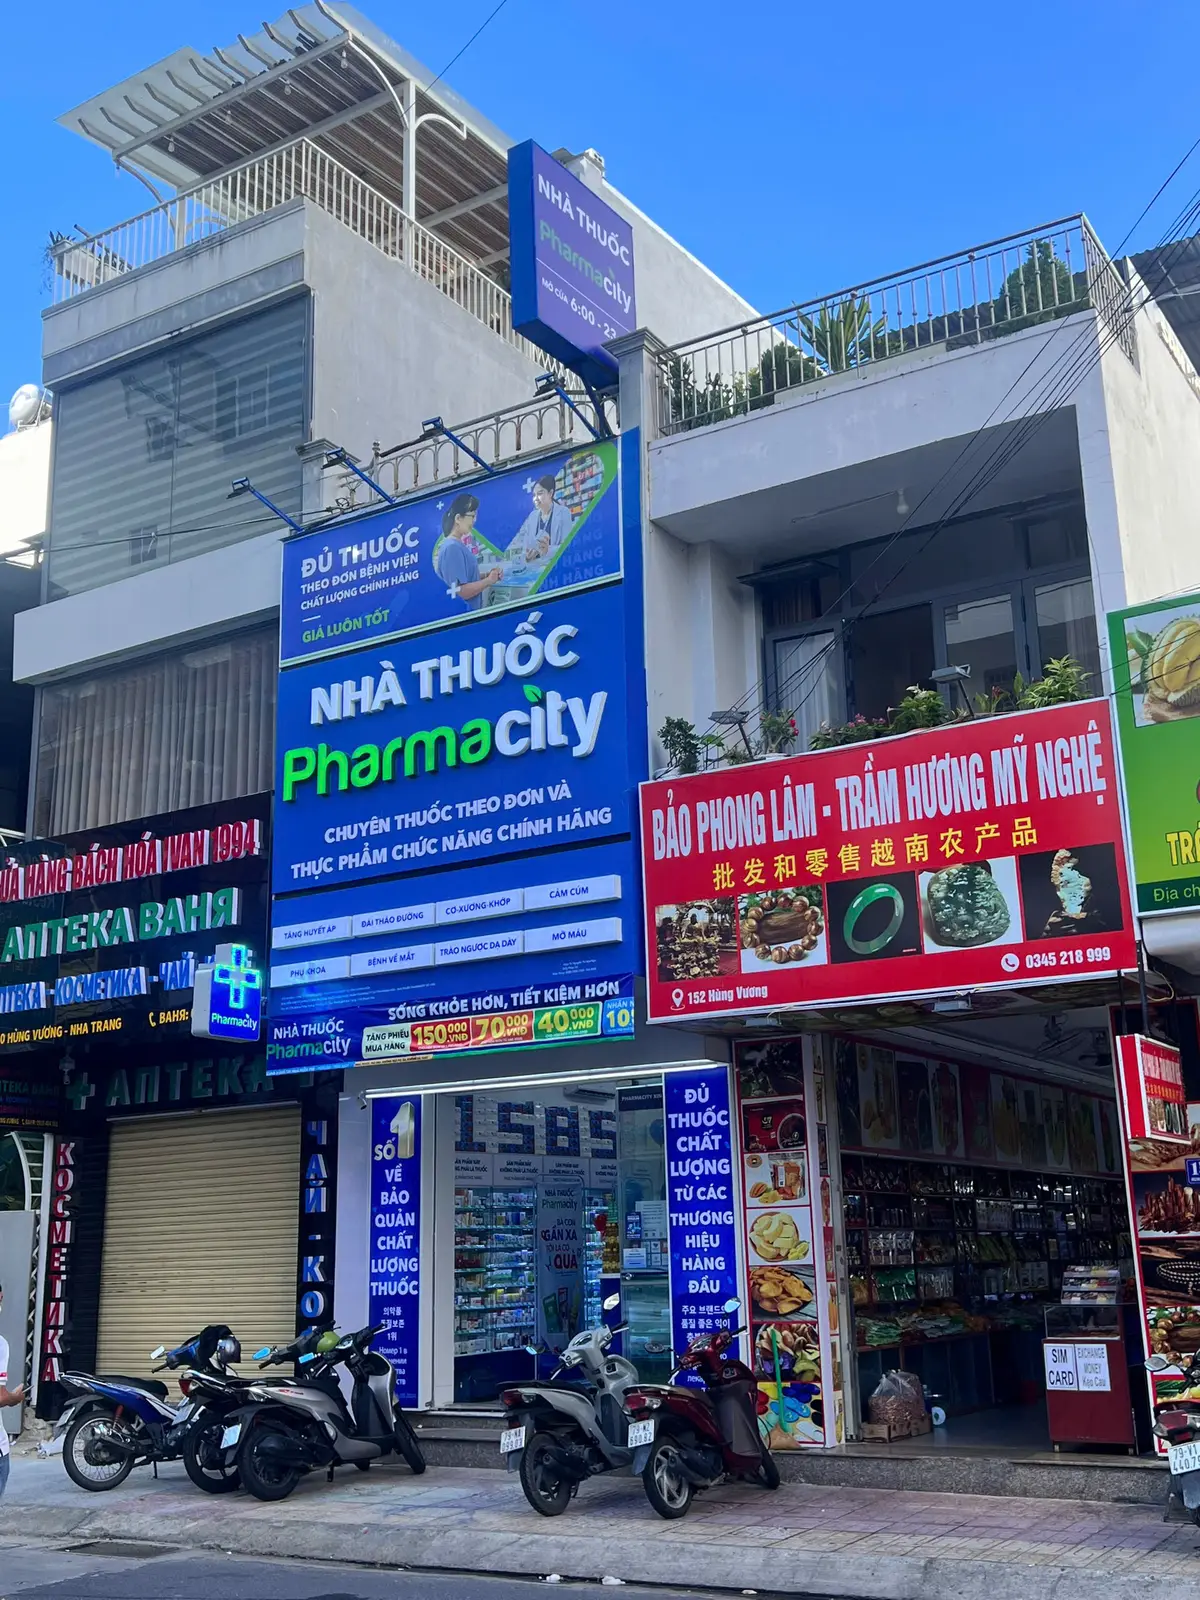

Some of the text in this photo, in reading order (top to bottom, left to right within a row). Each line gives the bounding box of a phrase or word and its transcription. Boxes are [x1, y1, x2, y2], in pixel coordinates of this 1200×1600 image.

[538, 173, 630, 266] NHÀ THUỐC
[540, 219, 631, 314] Pharmacity
[570, 297, 594, 326] 6:00
[301, 523, 420, 578] ĐỦ THUỐC
[300, 552, 418, 594] THEO ĐƠN BỆNH VIỆN
[301, 570, 419, 610] CHẤT LƯỢNG CHÍNH HÃNG
[302, 607, 390, 643] GIÁ LUÔN TỐT
[310, 611, 580, 725] NHÀ THUỐC
[283, 684, 608, 802] Pharmacity
[652, 719, 1107, 860] BẢO PHONG LÂM - TRẦM HƯƠNG MỸ NGHỆ
[324, 779, 572, 844] CHUYÊN THUỐC THEO ĐƠN VÀ
[291, 807, 612, 880] THỰC PHẨM CHỨC NĂNG CHÍNH HÃNG
[713, 816, 1038, 891] 批发和零售越南农产品
[0, 819, 260, 903] ỬA HÀNG BÁCH HÓA IVAN 1994
[550, 886, 589, 899] CẢM CÚM
[1154, 888, 1179, 904] Địa
[1, 887, 239, 962] АПТЕКА ВАНЯ
[396, 911, 424, 923] ĐƯỜNG
[304, 925, 326, 936] HUYẾT
[568, 929, 587, 939] MÁU
[461, 942, 488, 954] NGƯỢC
[1026, 947, 1110, 969] 0345 218 999
[307, 967, 326, 976] KHOA
[368, 957, 389, 968] BỆNH
[54, 966, 146, 1006] КОСМЕТИКА
[160, 951, 194, 991] ЧАЙ
[388, 1002, 425, 1020] SỐNG
[429, 996, 468, 1016] KHỎE
[472, 994, 508, 1011] HƠN,
[511, 986, 541, 1004] TIẾT
[544, 984, 580, 1004] KIỆM
[585, 980, 619, 998] HƠN
[688, 984, 768, 1005] 152 Hùng Vương
[159, 1009, 189, 1024] ВАНЯ:
[211, 1013, 257, 1030] Pharmacity
[538, 1007, 594, 1033] 40 000
[7, 1018, 122, 1044] HÙNG VƯƠNG NHA TRANG
[274, 1017, 344, 1040] NHÀ THUỐC
[388, 1030, 409, 1040] PHIẾU
[413, 1022, 467, 1045] 150 000
[476, 1018, 504, 1041] 70
[506, 1014, 528, 1026] 000
[266, 1034, 350, 1060] Pharmacity
[365, 1044, 382, 1053] MUA
[684, 1082, 709, 1104] ĐỦ
[668, 1105, 729, 1128] THUỐC
[374, 1101, 415, 1161] SỐ 1
[676, 1129, 722, 1152] CHẤT
[385, 1163, 402, 1182] VỀ
[670, 1158, 730, 1180] LƯỢNG
[381, 1186, 410, 1205] BẢO
[674, 1183, 727, 1201] TỪ CÁC
[542, 1199, 578, 1211] Pharmacity
[375, 1208, 415, 1228] QUẢN
[670, 1210, 734, 1226] THƯƠNG
[377, 1230, 413, 1250] CHẤT
[565, 1230, 577, 1241] XA
[685, 1231, 720, 1252] HIỆU
[42, 1141, 75, 1382] КОСМЕТИКА
[371, 1257, 418, 1277] LƯỢNG
[682, 1254, 725, 1271] HÀNG
[370, 1276, 418, 1296] THUỐC
[688, 1275, 720, 1293] ĐẦU
[383, 1306, 402, 1316] 의약품
[682, 1305, 696, 1315] 주요
[681, 1319, 695, 1329] 품질
[379, 1346, 398, 1355] Номер
[1052, 1349, 1067, 1363] SIM
[1078, 1348, 1105, 1358] EXCHANGE
[1049, 1371, 1074, 1385] CARD
[1084, 1363, 1101, 1374] MONEY
